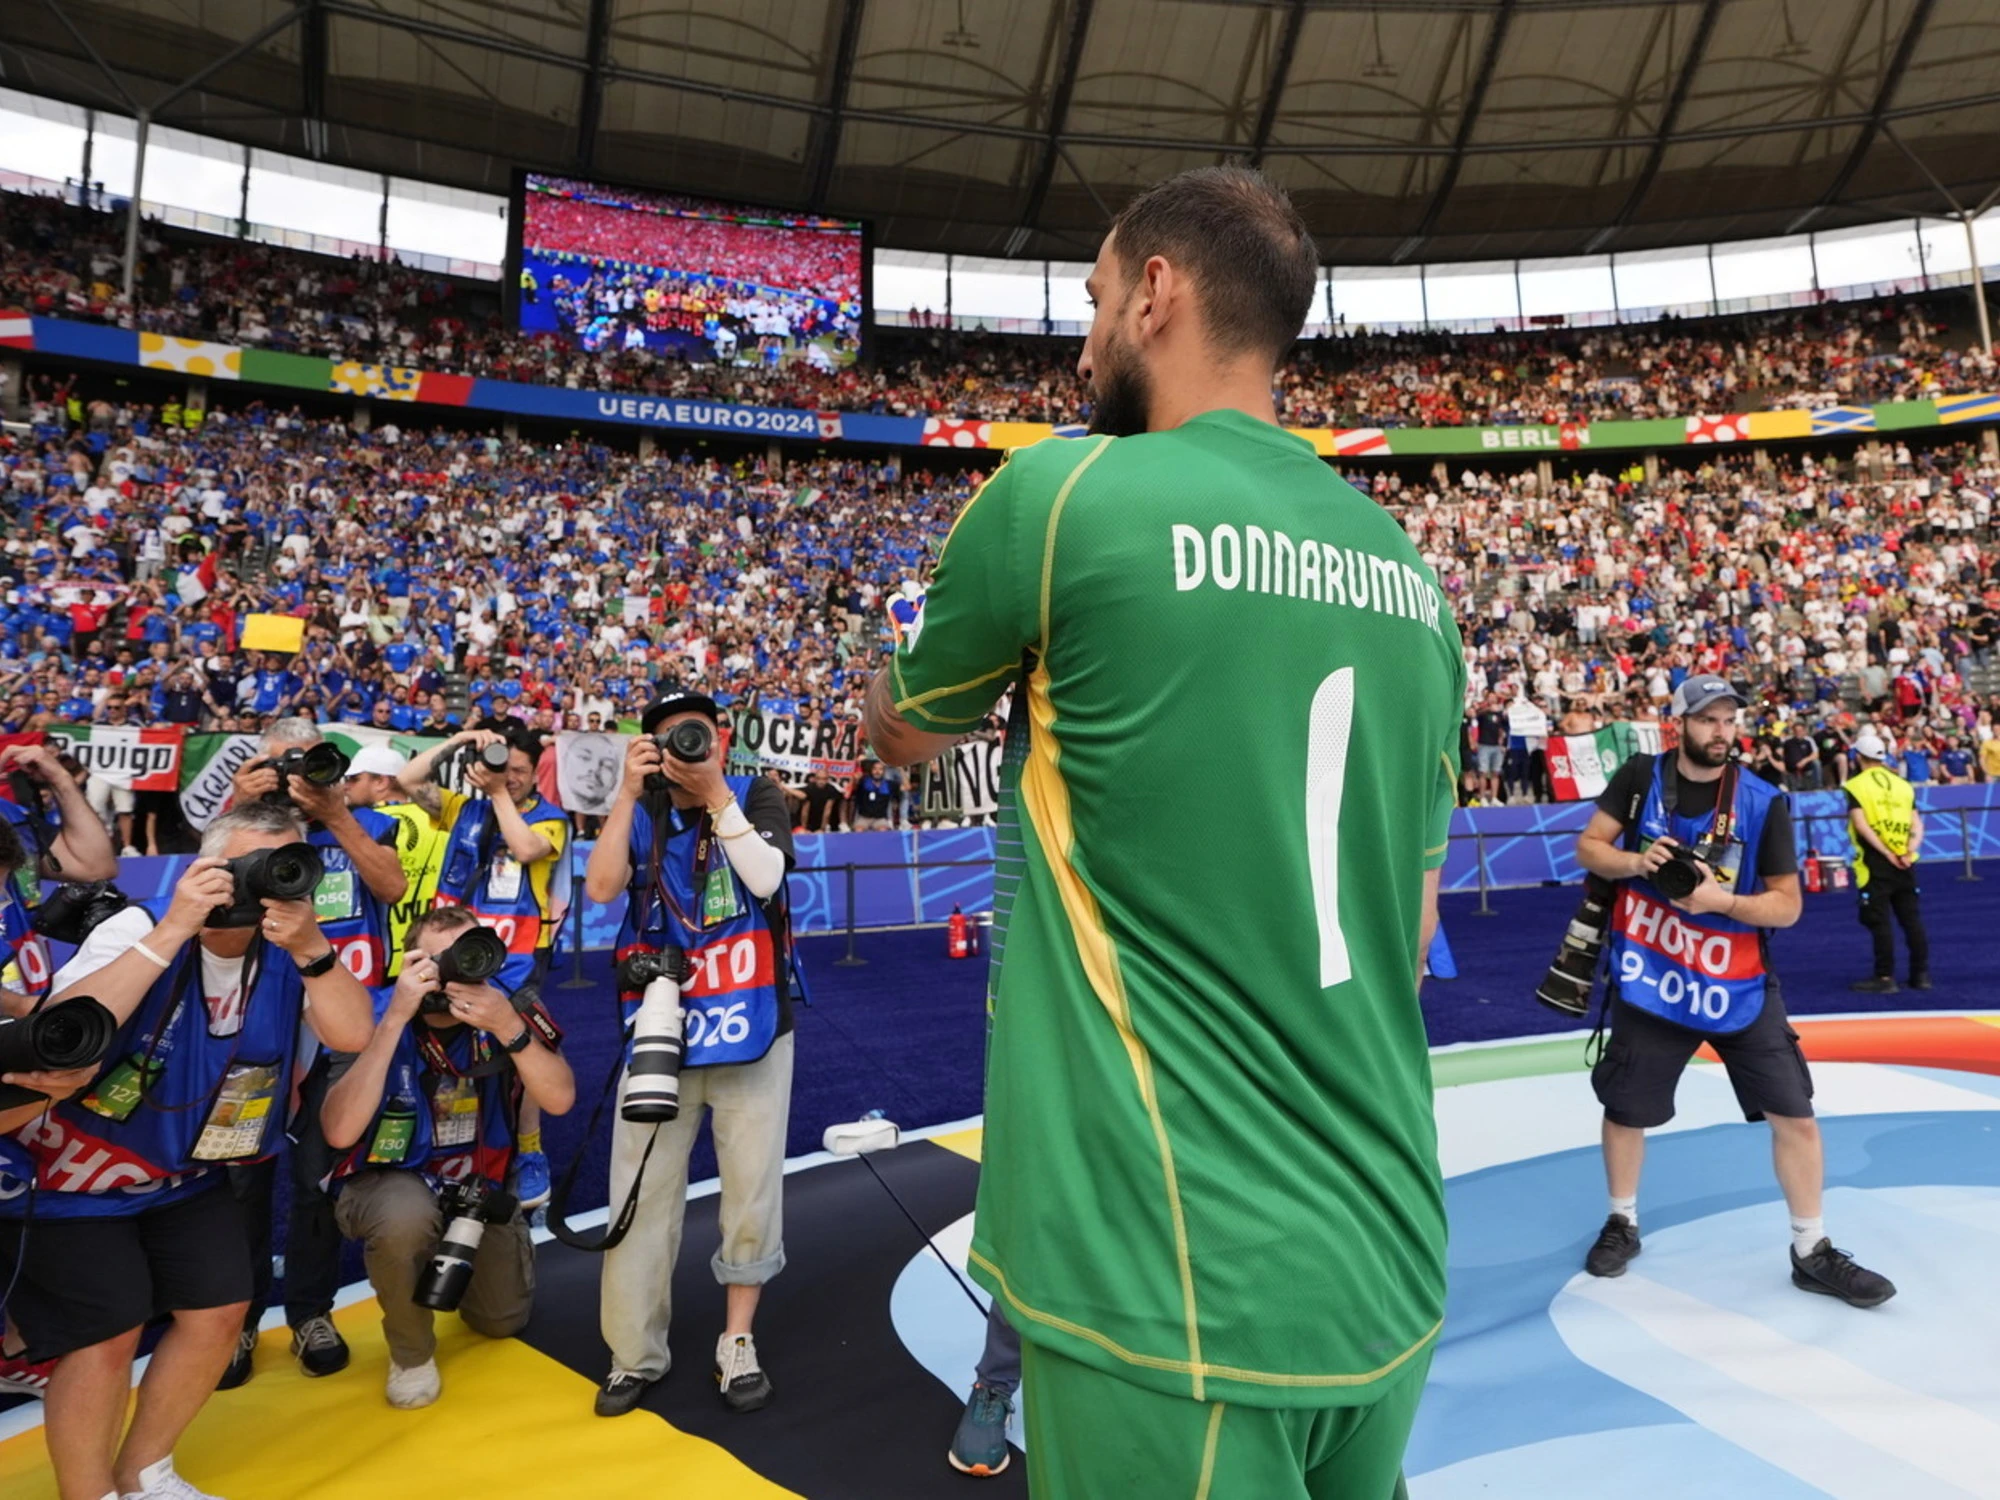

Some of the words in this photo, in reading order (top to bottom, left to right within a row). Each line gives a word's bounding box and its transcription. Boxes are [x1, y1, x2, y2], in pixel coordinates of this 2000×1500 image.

[1481, 428, 1590, 449] BERLN
[1171, 523, 1442, 637] DONNARUMMA
[1306, 667, 1354, 989] 1
[315, 891, 349, 906] 050
[1620, 950, 1730, 1020] 9-010
[106, 1083, 142, 1104] 127
[378, 1137, 405, 1150] 130
